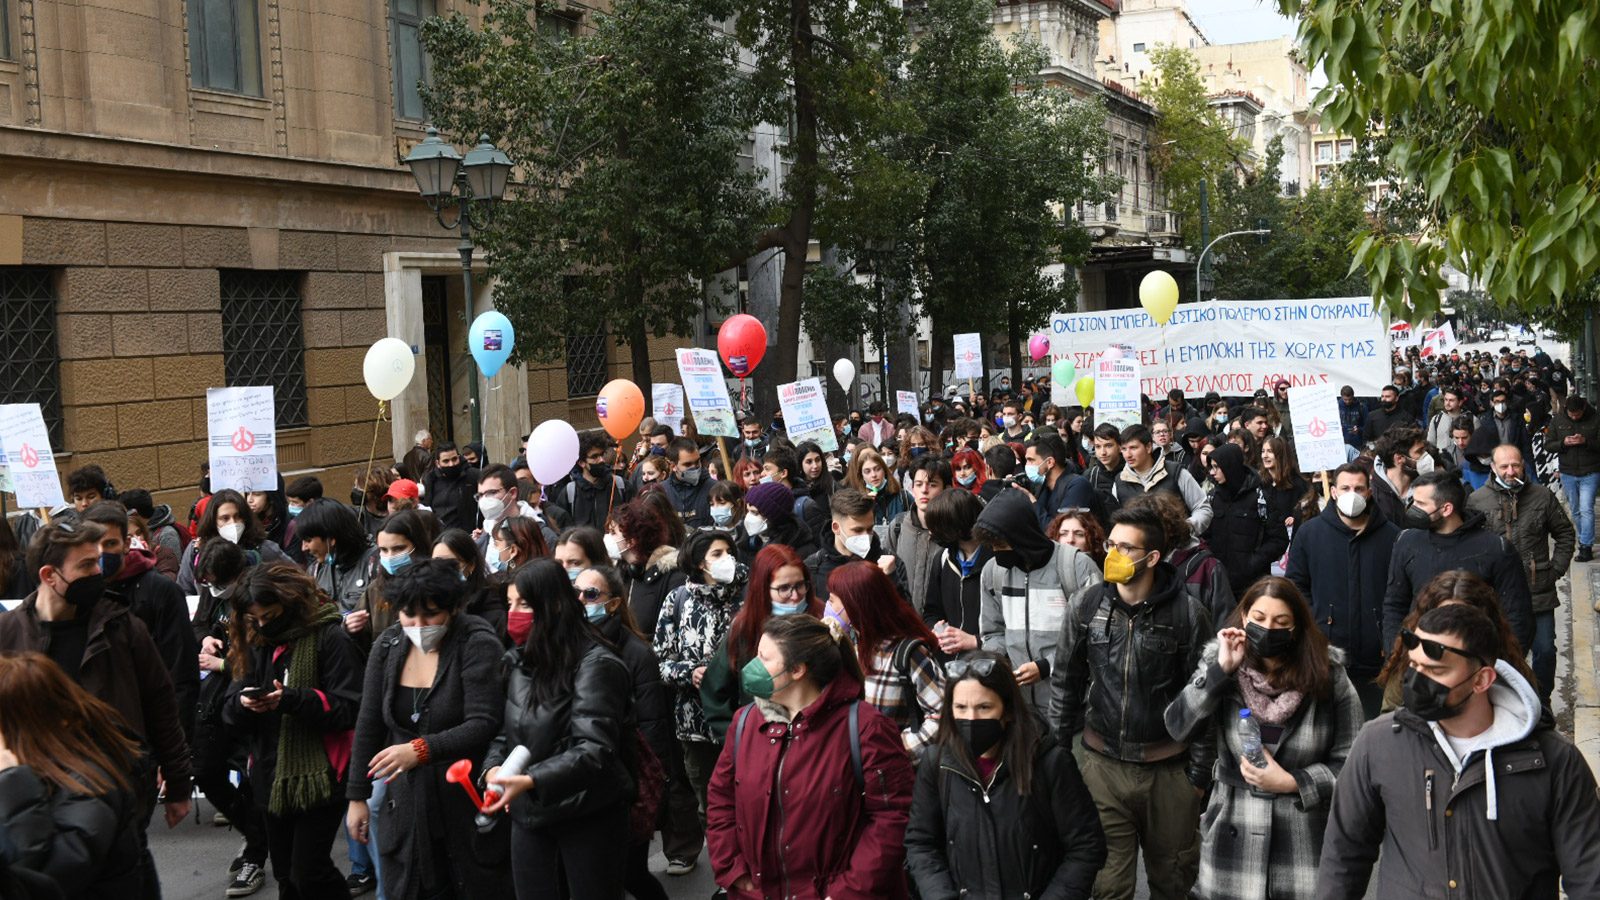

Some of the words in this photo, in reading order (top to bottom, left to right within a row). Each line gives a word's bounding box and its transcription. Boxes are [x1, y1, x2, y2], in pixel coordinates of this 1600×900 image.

[1054, 317, 1077, 334] ΟΧΙ
[1079, 316, 1107, 331] ΣΤΟΝ
[1111, 307, 1216, 330] ΙΜΠΕΡΙΙΣΤΙΚΟ
[1219, 306, 1271, 321] ΠΟΛΕΜΟ
[1275, 305, 1308, 320] ΣΤΗΝ
[1165, 348, 1175, 363] Η
[1179, 341, 1244, 363] ΕΜΠΛΟΚΗ
[1248, 342, 1277, 359] ΤΗΣ
[1284, 342, 1336, 359] ΧΩΡΑΣ
[1341, 340, 1376, 359] ΜΑΣ
[1185, 373, 1254, 392] ΣΥΛΛΟΓΟΙ
